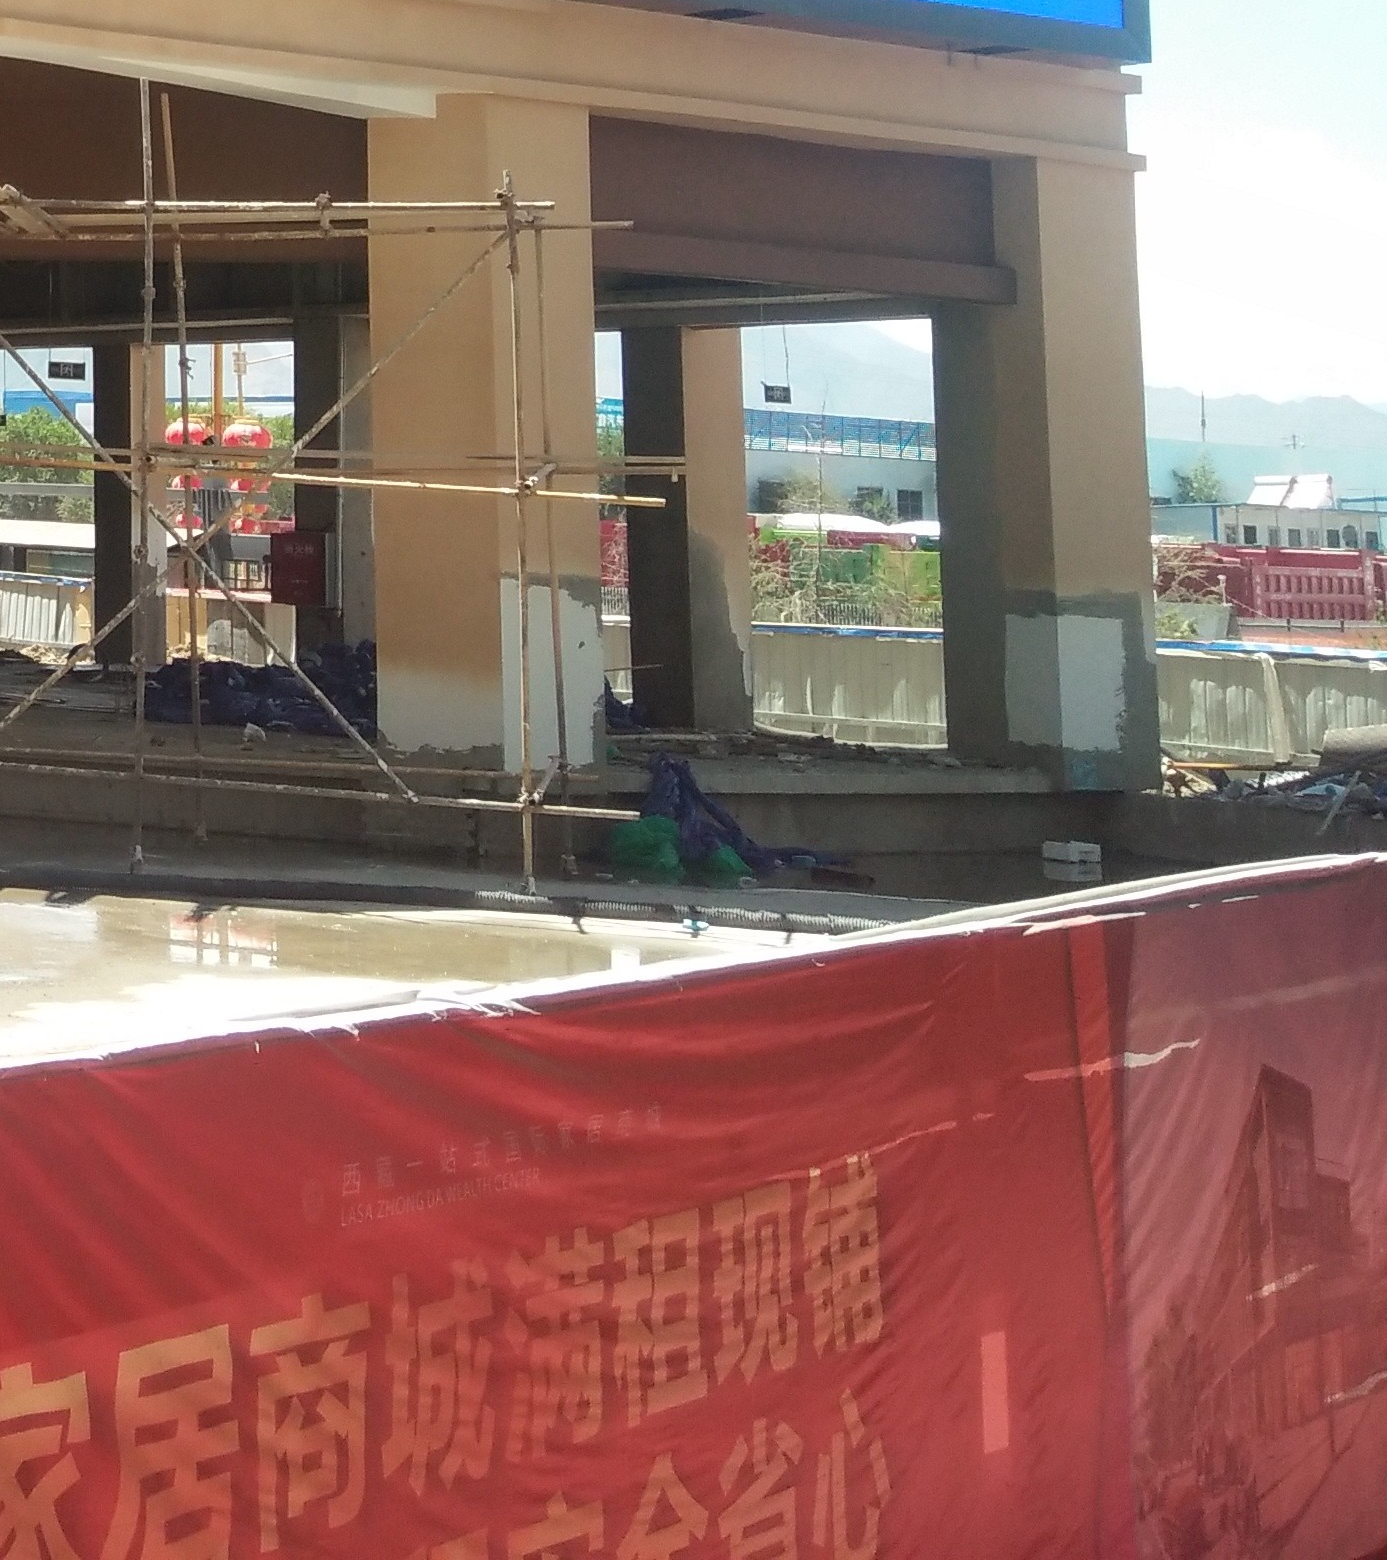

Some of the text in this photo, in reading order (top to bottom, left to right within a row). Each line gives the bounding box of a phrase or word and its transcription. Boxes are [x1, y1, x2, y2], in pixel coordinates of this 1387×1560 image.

[340, 1204, 373, 1228] LASA
[376, 1193, 424, 1220] ZHONG
[445, 1177, 492, 1204] WEALTH
